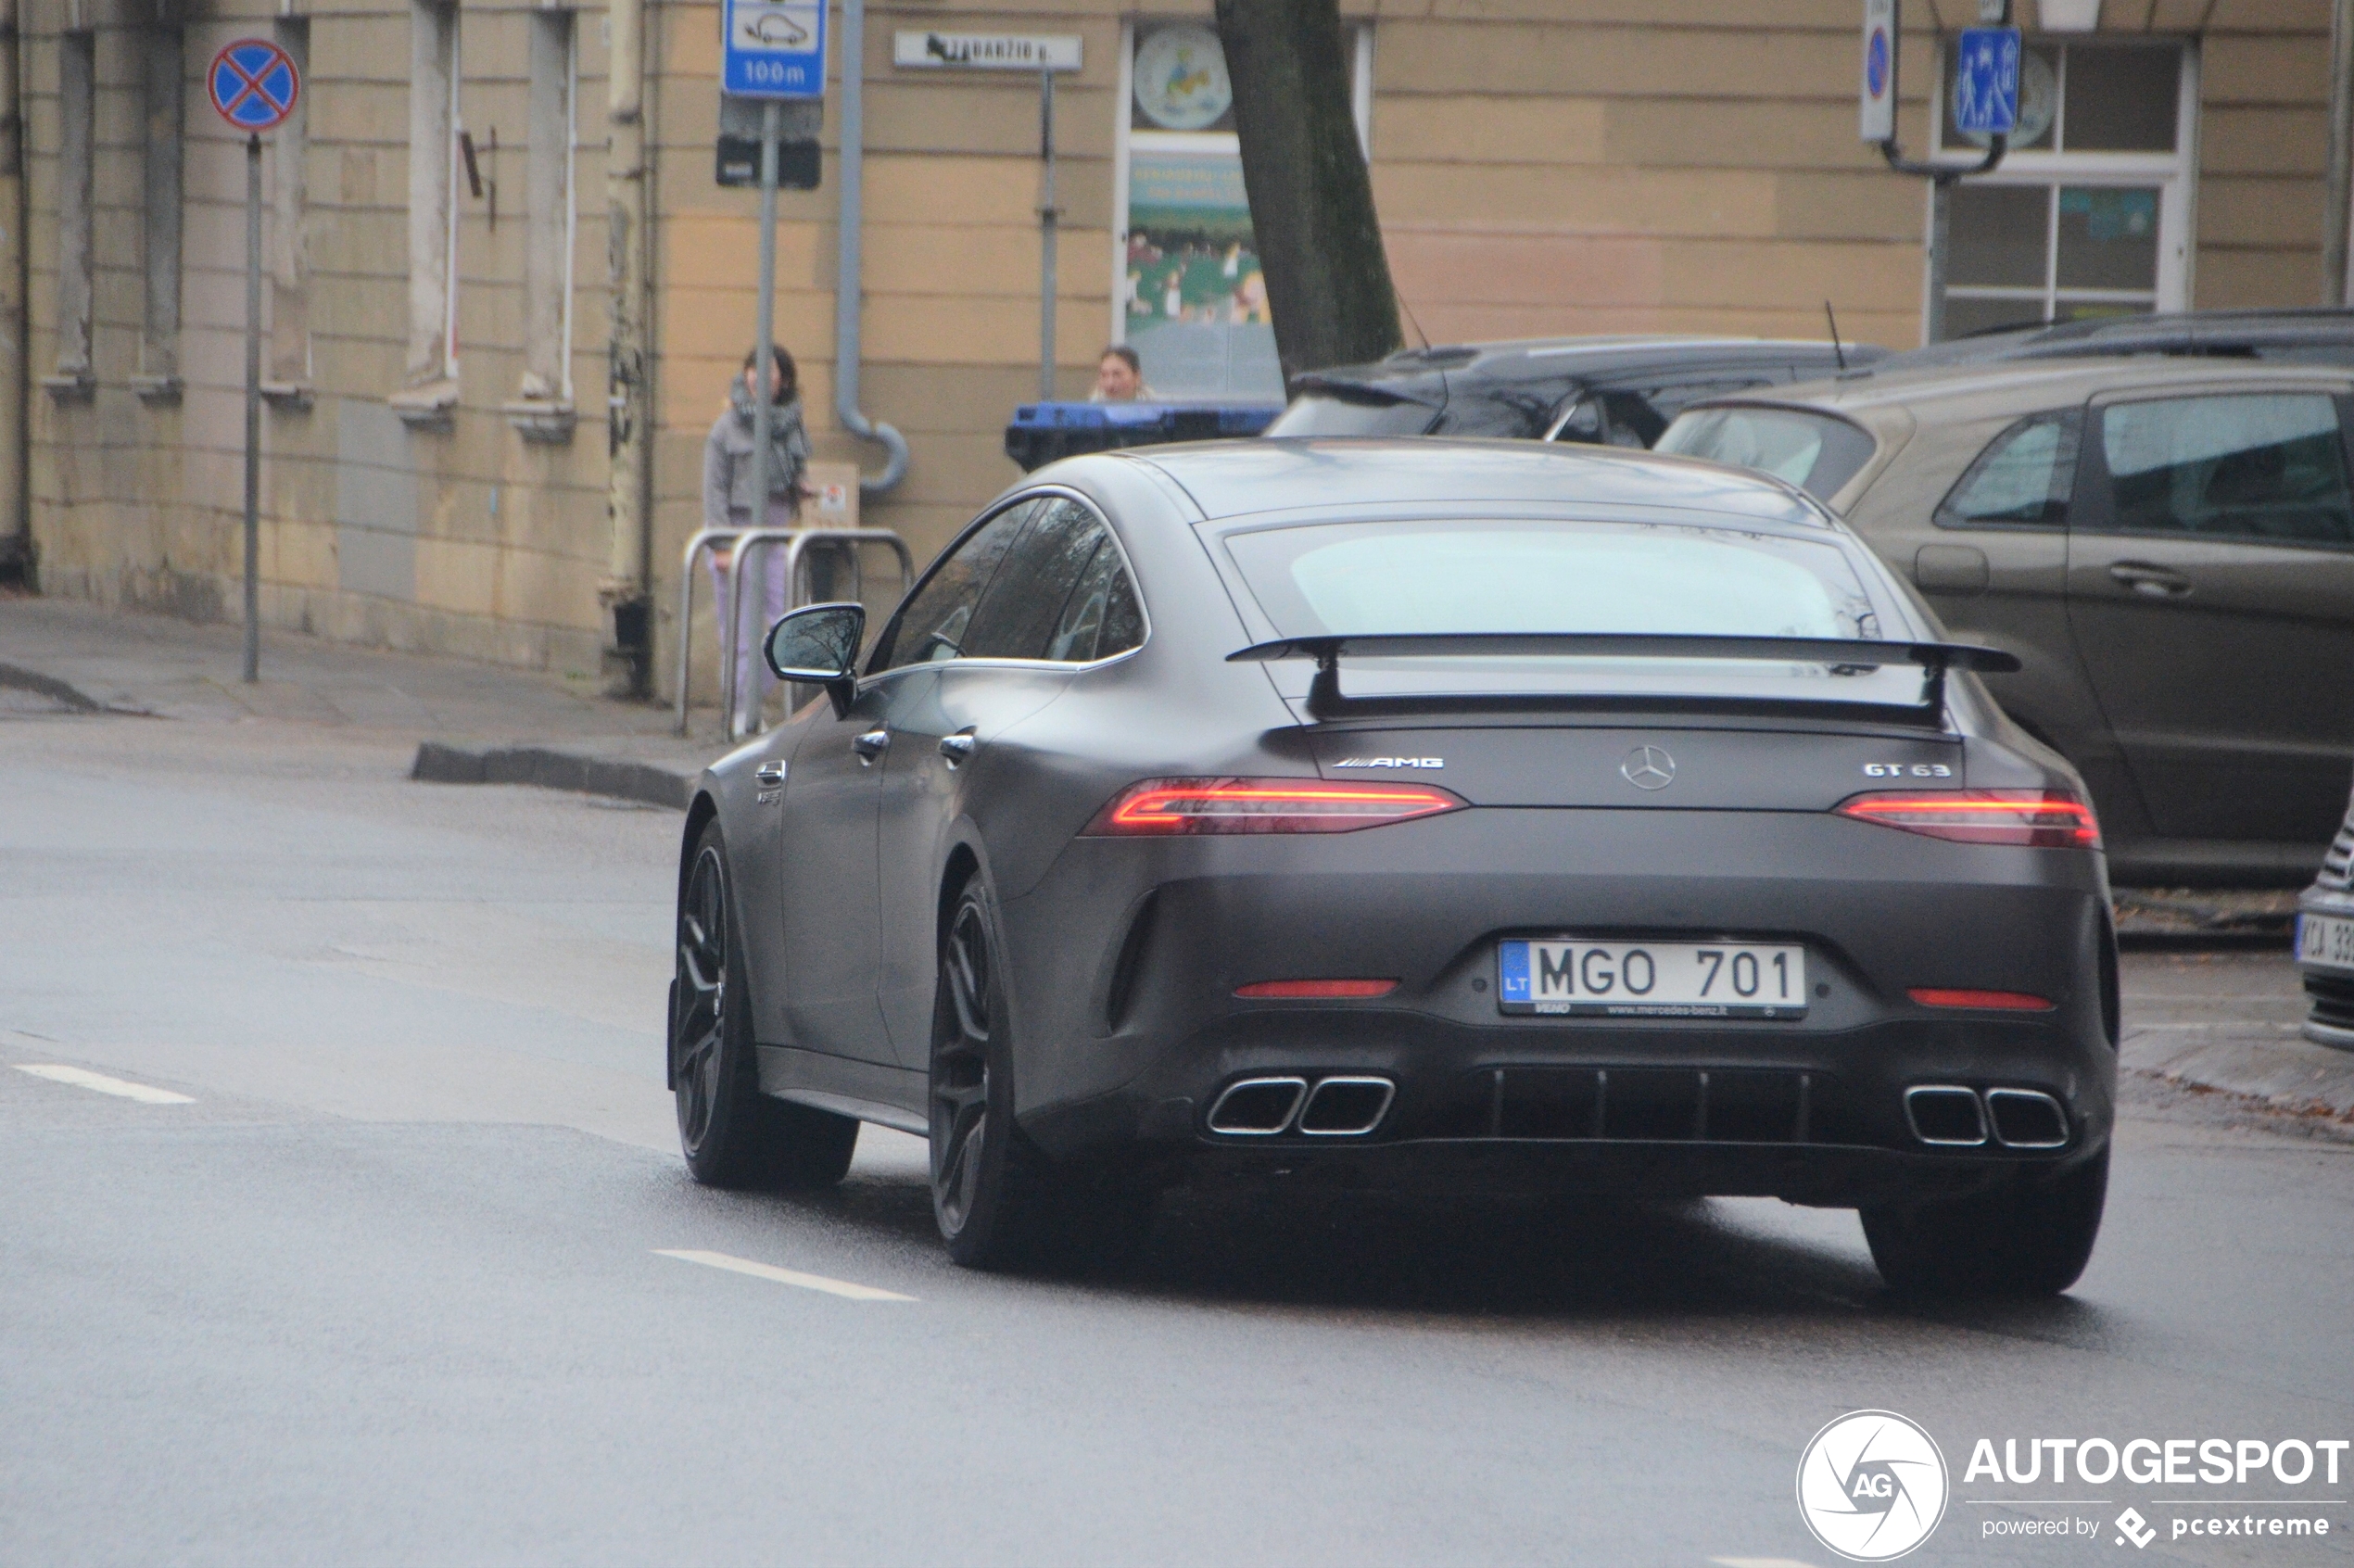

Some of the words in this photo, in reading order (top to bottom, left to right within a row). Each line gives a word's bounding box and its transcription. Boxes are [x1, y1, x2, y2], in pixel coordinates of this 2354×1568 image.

[745, 60, 805, 85] 100m
[1864, 763, 1903, 777] GT
[1911, 764, 1952, 778] 63
[1539, 948, 1656, 995] MGO
[1697, 950, 1789, 999] 701
[1505, 977, 1528, 992] LT
